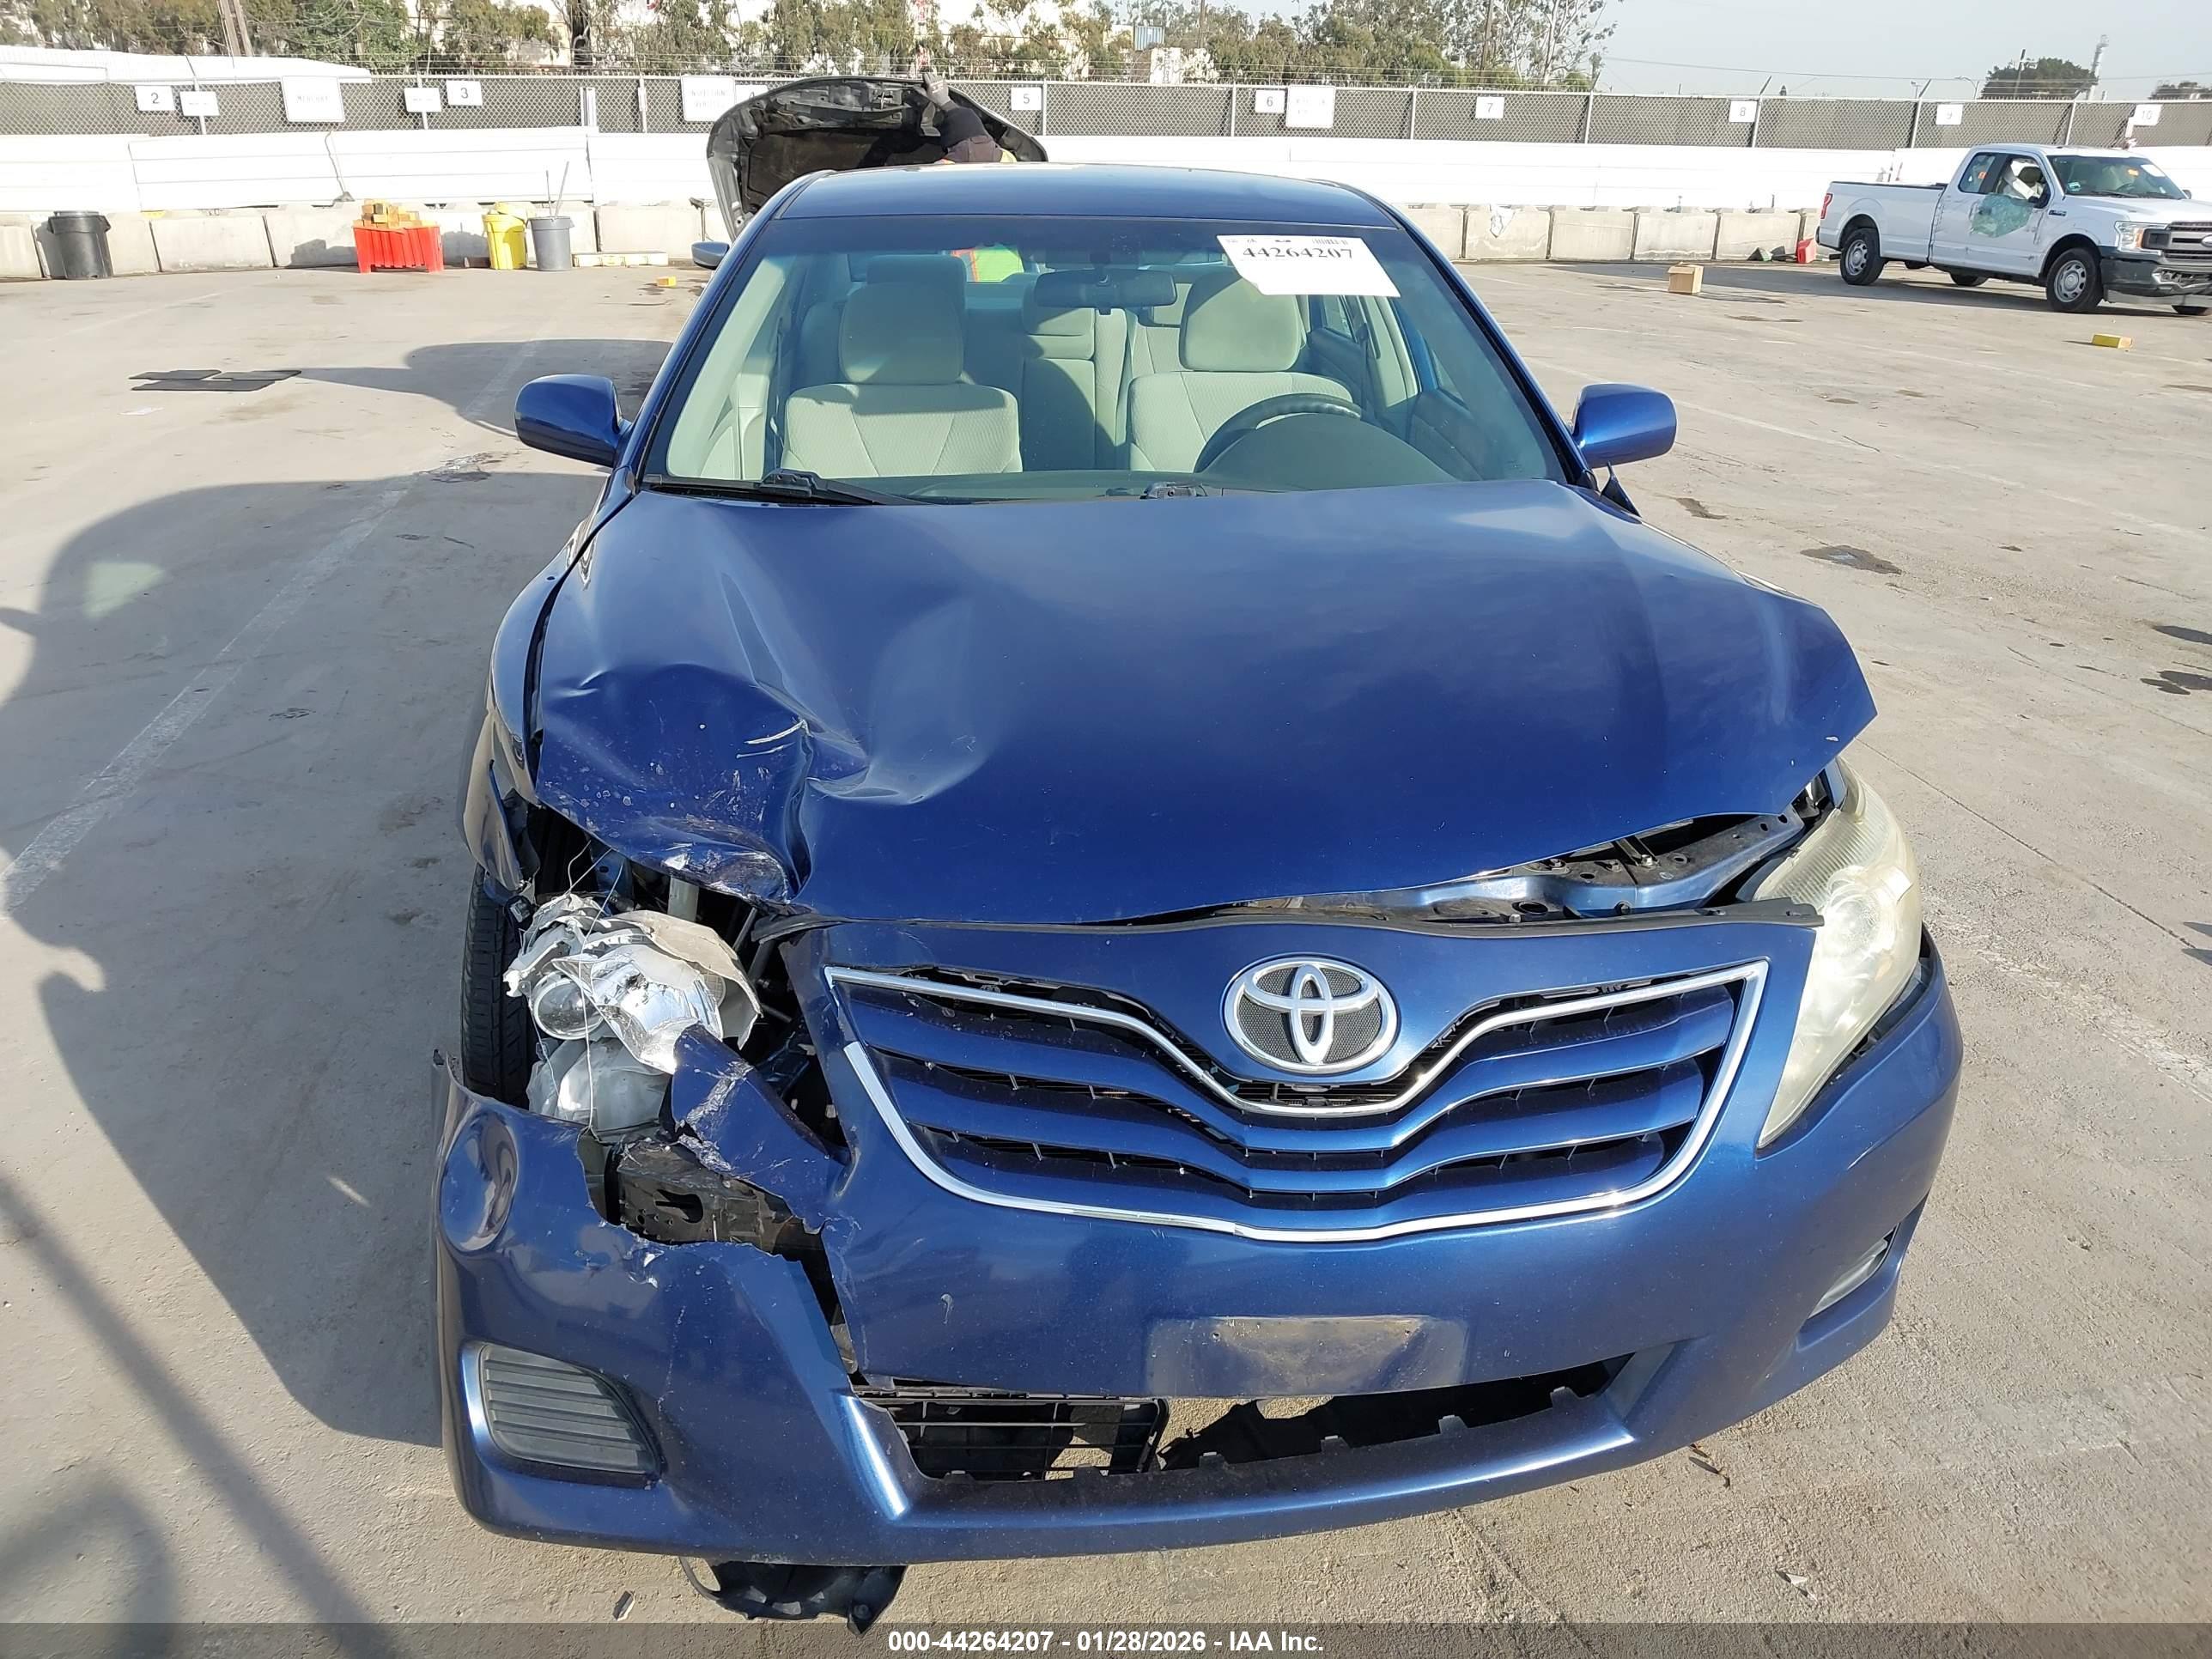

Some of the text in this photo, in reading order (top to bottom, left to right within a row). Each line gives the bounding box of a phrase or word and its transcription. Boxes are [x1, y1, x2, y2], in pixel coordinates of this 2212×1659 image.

[150, 92, 161, 105] 2
[460, 87, 470, 100] 3
[1023, 94, 1030, 105] 5
[1266, 96, 1273, 107] 6
[1486, 102, 1494, 112] 7
[1739, 106, 1747, 118] 8
[1945, 110, 1953, 120] 9
[1243, 247, 1352, 259] 44264207
